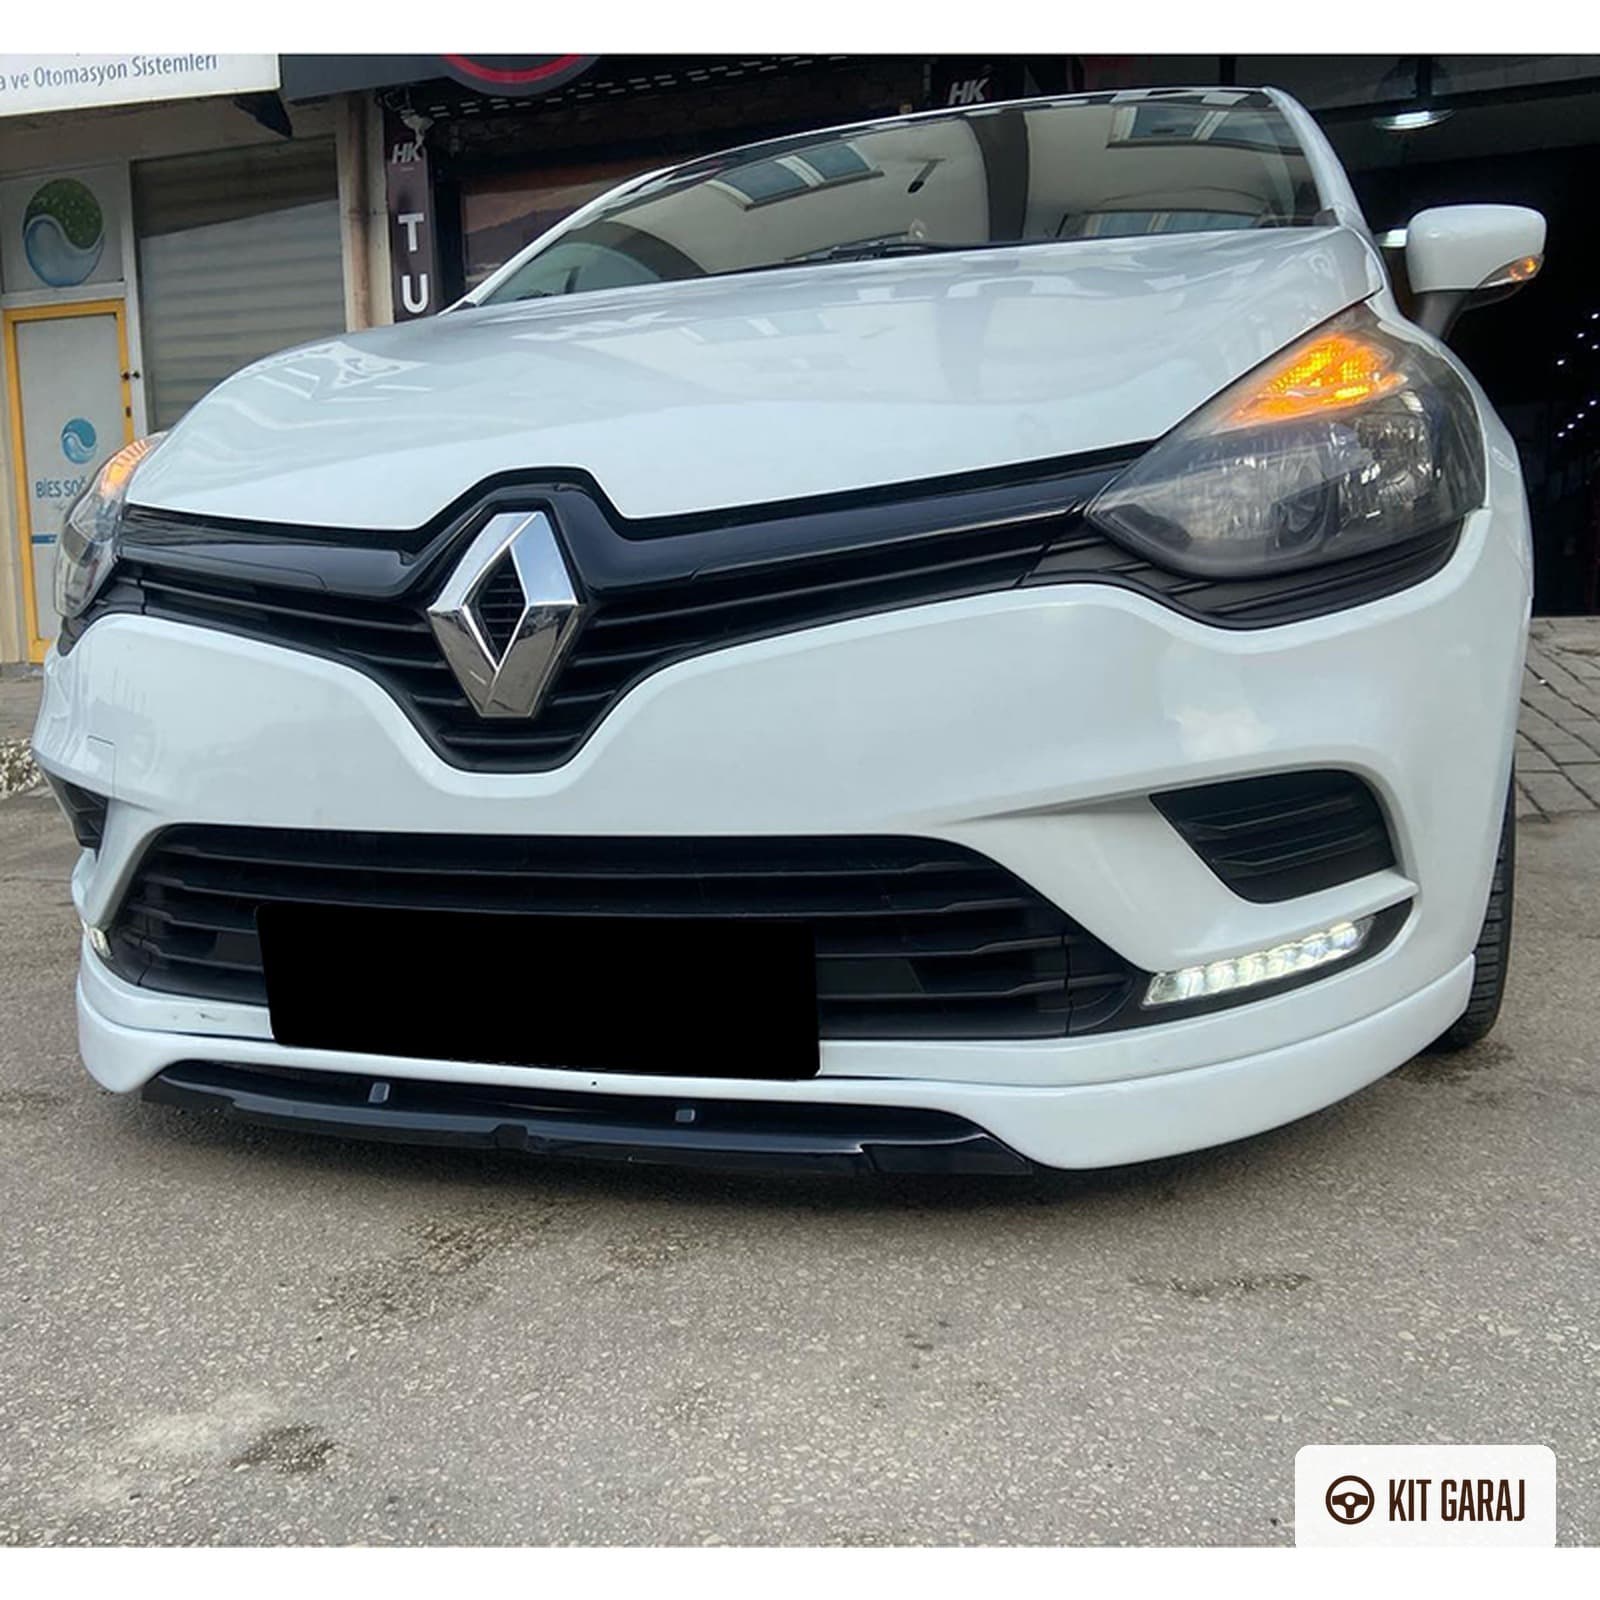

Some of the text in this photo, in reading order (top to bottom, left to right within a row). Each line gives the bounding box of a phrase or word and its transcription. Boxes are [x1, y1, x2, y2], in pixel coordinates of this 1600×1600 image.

[10, 73, 30, 90] ve
[34, 63, 128, 88] Otomasyon
[131, 54, 217, 77] Sistemleri
[949, 78, 989, 105] HK
[392, 141, 422, 164] HK
